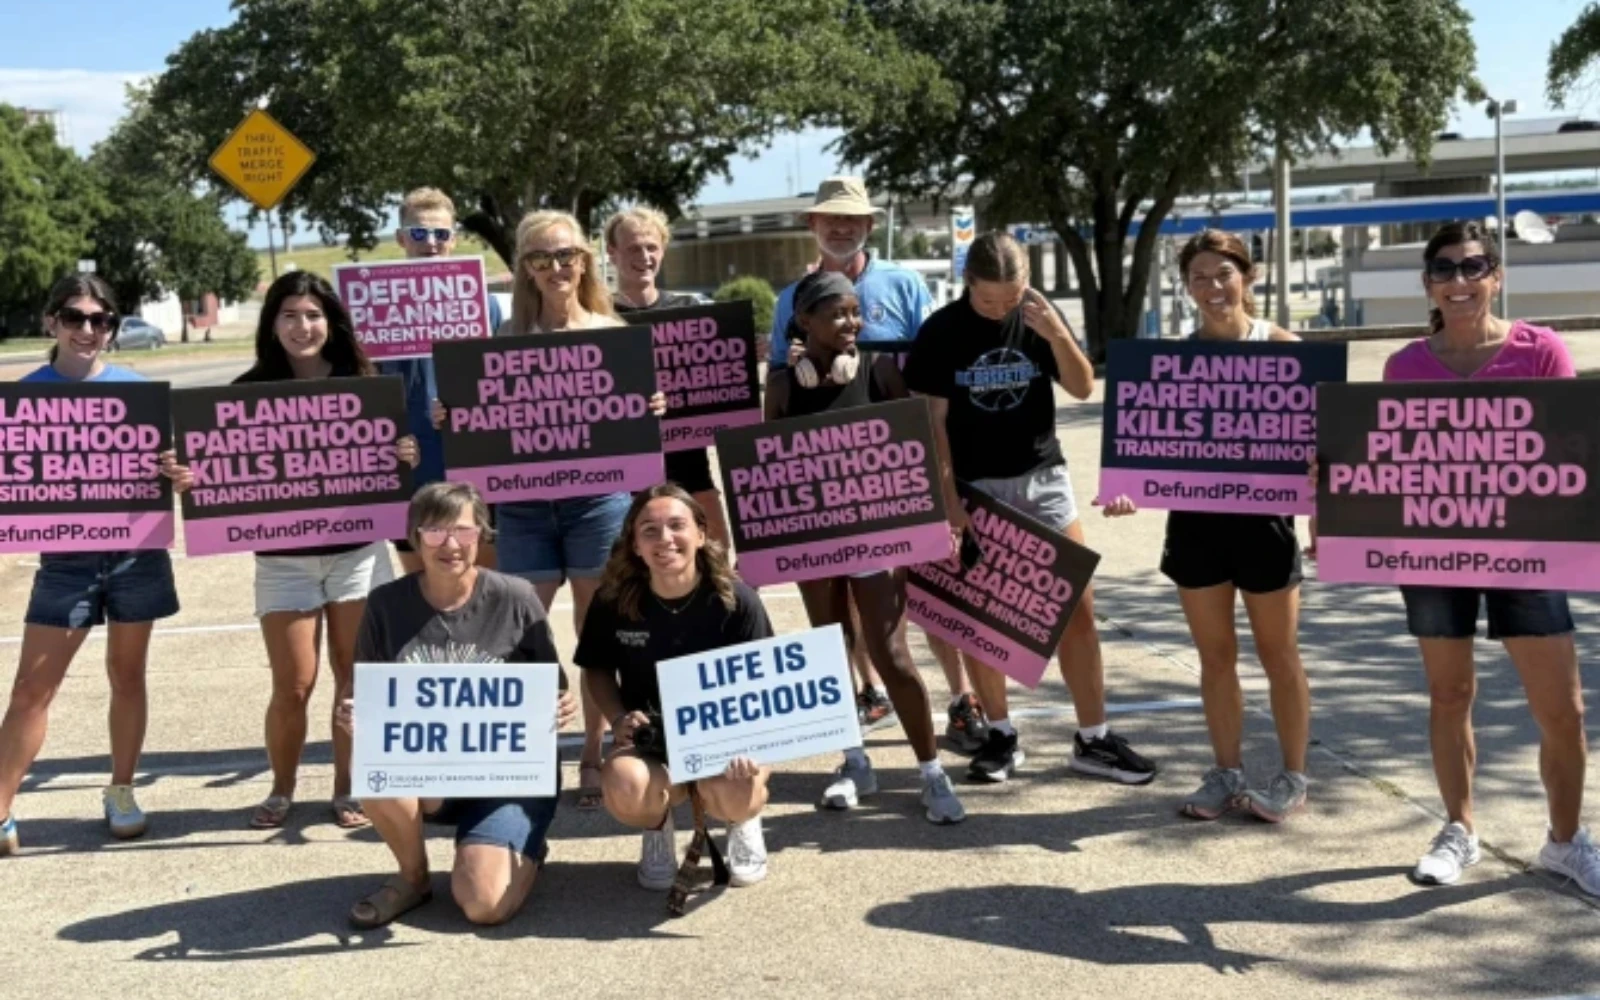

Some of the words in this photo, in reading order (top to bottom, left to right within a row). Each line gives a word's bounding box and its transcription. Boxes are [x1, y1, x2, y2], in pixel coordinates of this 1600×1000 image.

[238, 145, 285, 157] TRAFFIC
[245, 133, 275, 143] THRU
[240, 159, 285, 170] MERGE
[243, 171, 283, 183] RIGHT
[347, 274, 478, 306] DEFUND
[350, 300, 480, 327] PLANNED
[354, 322, 483, 344] PARENTHOOD
[651, 317, 717, 344] NNED
[483, 344, 603, 378] DEFUND
[654, 338, 746, 368] THOOD
[656, 361, 748, 392] BABIES
[1151, 355, 1301, 383] PLANNED
[478, 370, 614, 404] PLANNED
[687, 385, 751, 406] MINORS
[1117, 381, 1316, 411] PARENTHOO
[0, 397, 127, 424] LANNED
[216, 392, 363, 428] PLANNED
[451, 393, 647, 432] PARENTHOOD
[1117, 409, 1204, 438] KILLS
[1378, 397, 1534, 430] DEFUND
[0, 424, 161, 452] ENTHOOD
[185, 418, 397, 457] PARENTHOOD
[510, 424, 591, 454] NOW!
[755, 418, 890, 463] PLANNED
[1114, 439, 1245, 460] TRANSITIONS
[1367, 431, 1545, 462] PLANNED
[42, 452, 160, 481] BABIES
[190, 455, 278, 486] KILLS
[283, 445, 399, 477] BABIES
[487, 468, 624, 492] DefundPP.com
[730, 440, 925, 493] PARENTHOOD
[1329, 463, 1588, 497] PARENTHOOD
[0, 483, 77, 502] SITIONS
[81, 481, 162, 500] MINORS
[191, 479, 320, 506] TRANSITIONS
[324, 474, 400, 494] MINORS
[737, 486, 816, 521] KILLS
[821, 467, 930, 508] BABIES
[1143, 479, 1298, 502] DefundPP.com
[740, 508, 858, 540] TRANSITIONS
[861, 495, 934, 521] MINORS
[1403, 496, 1507, 528] NOW!
[0, 523, 131, 542] efundPP.com
[227, 516, 374, 543] DefundPP.com
[971, 507, 1057, 566] ANNED
[776, 540, 912, 572] DefundPP.com
[980, 538, 1073, 603] THOOD
[1365, 549, 1547, 574] DefundPP.com
[964, 563, 1063, 627] BABIES
[907, 597, 1010, 662] efundPP.com
[985, 600, 1052, 645] MINORS
[697, 651, 765, 690] LIFE
[773, 641, 807, 674] IS
[388, 677, 397, 707] I
[416, 677, 524, 708] STAND
[675, 675, 842, 735] PRECIOUS
[383, 722, 448, 752] FOR
[460, 722, 527, 752] LIFE
